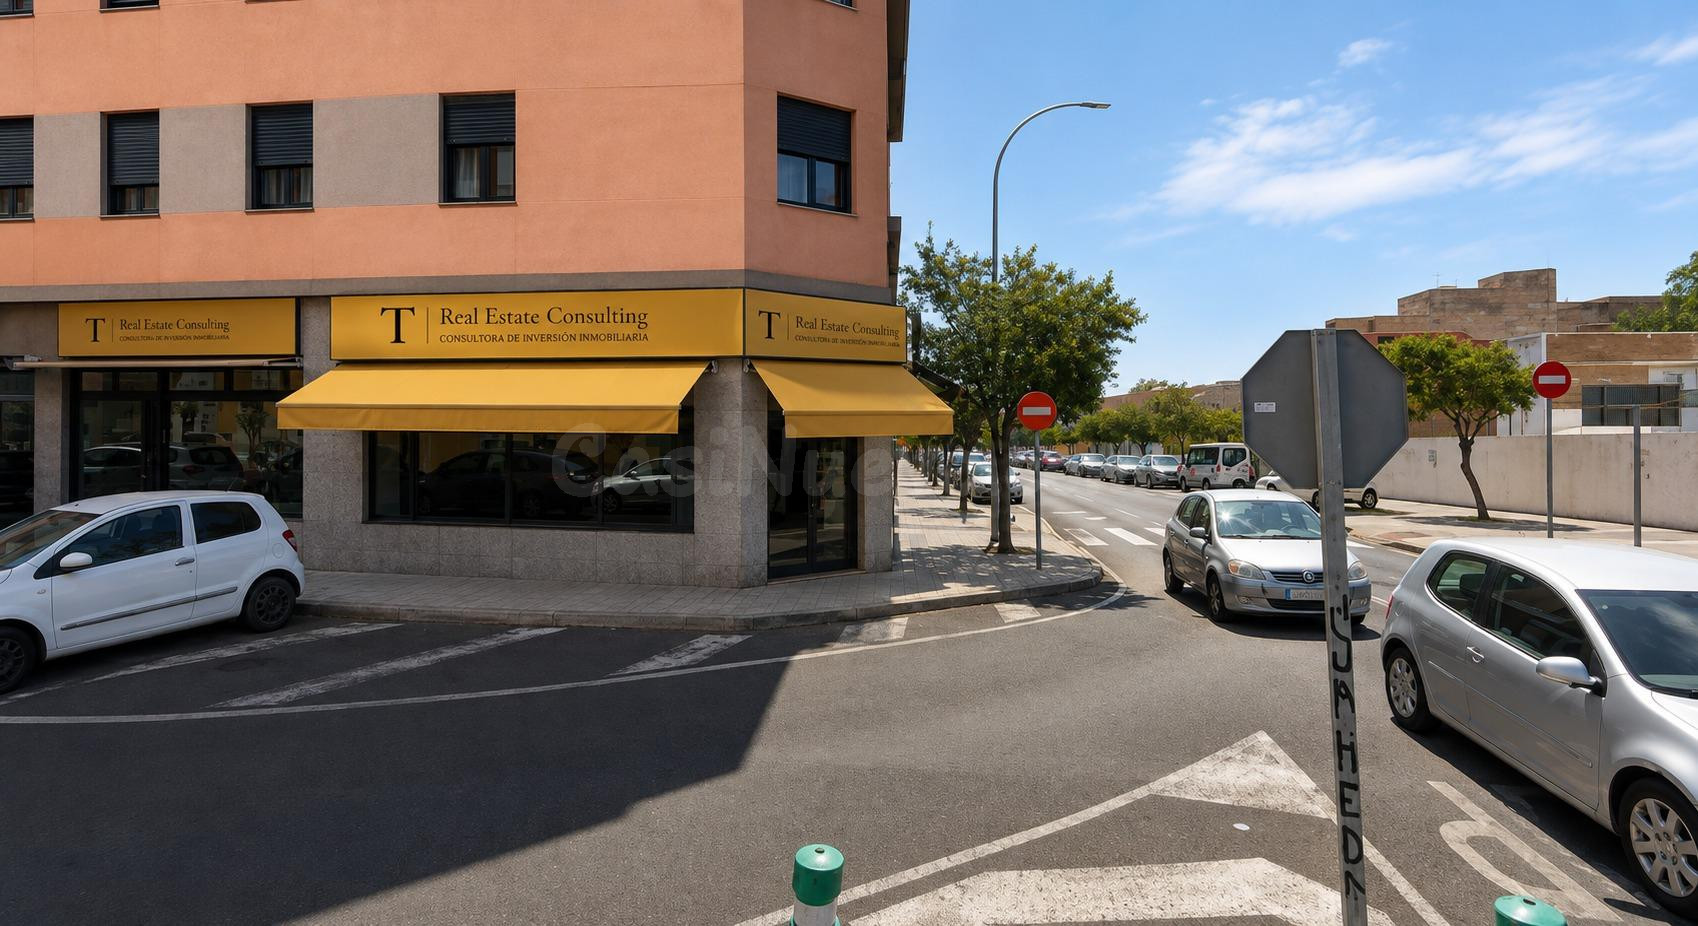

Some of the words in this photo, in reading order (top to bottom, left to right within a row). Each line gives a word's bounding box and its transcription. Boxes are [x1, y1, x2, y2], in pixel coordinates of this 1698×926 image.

[85, 317, 106, 342] T
[120, 318, 141, 330] Real
[144, 318, 173, 330] Estate
[176, 318, 230, 333] Consulting
[380, 306, 415, 344] T
[440, 306, 478, 325] Real
[486, 307, 539, 325] Estate
[547, 306, 649, 330] Consulting
[758, 310, 781, 340] T
[796, 316, 817, 330] Real
[821, 318, 850, 333] Estate
[852, 322, 900, 340] Consulting
[439, 333, 505, 343] CONSULTORA
[507, 334, 520, 343] DE
[523, 331, 576, 343] INVERSIÓN
[579, 332, 649, 342] INMOBILIARIA
